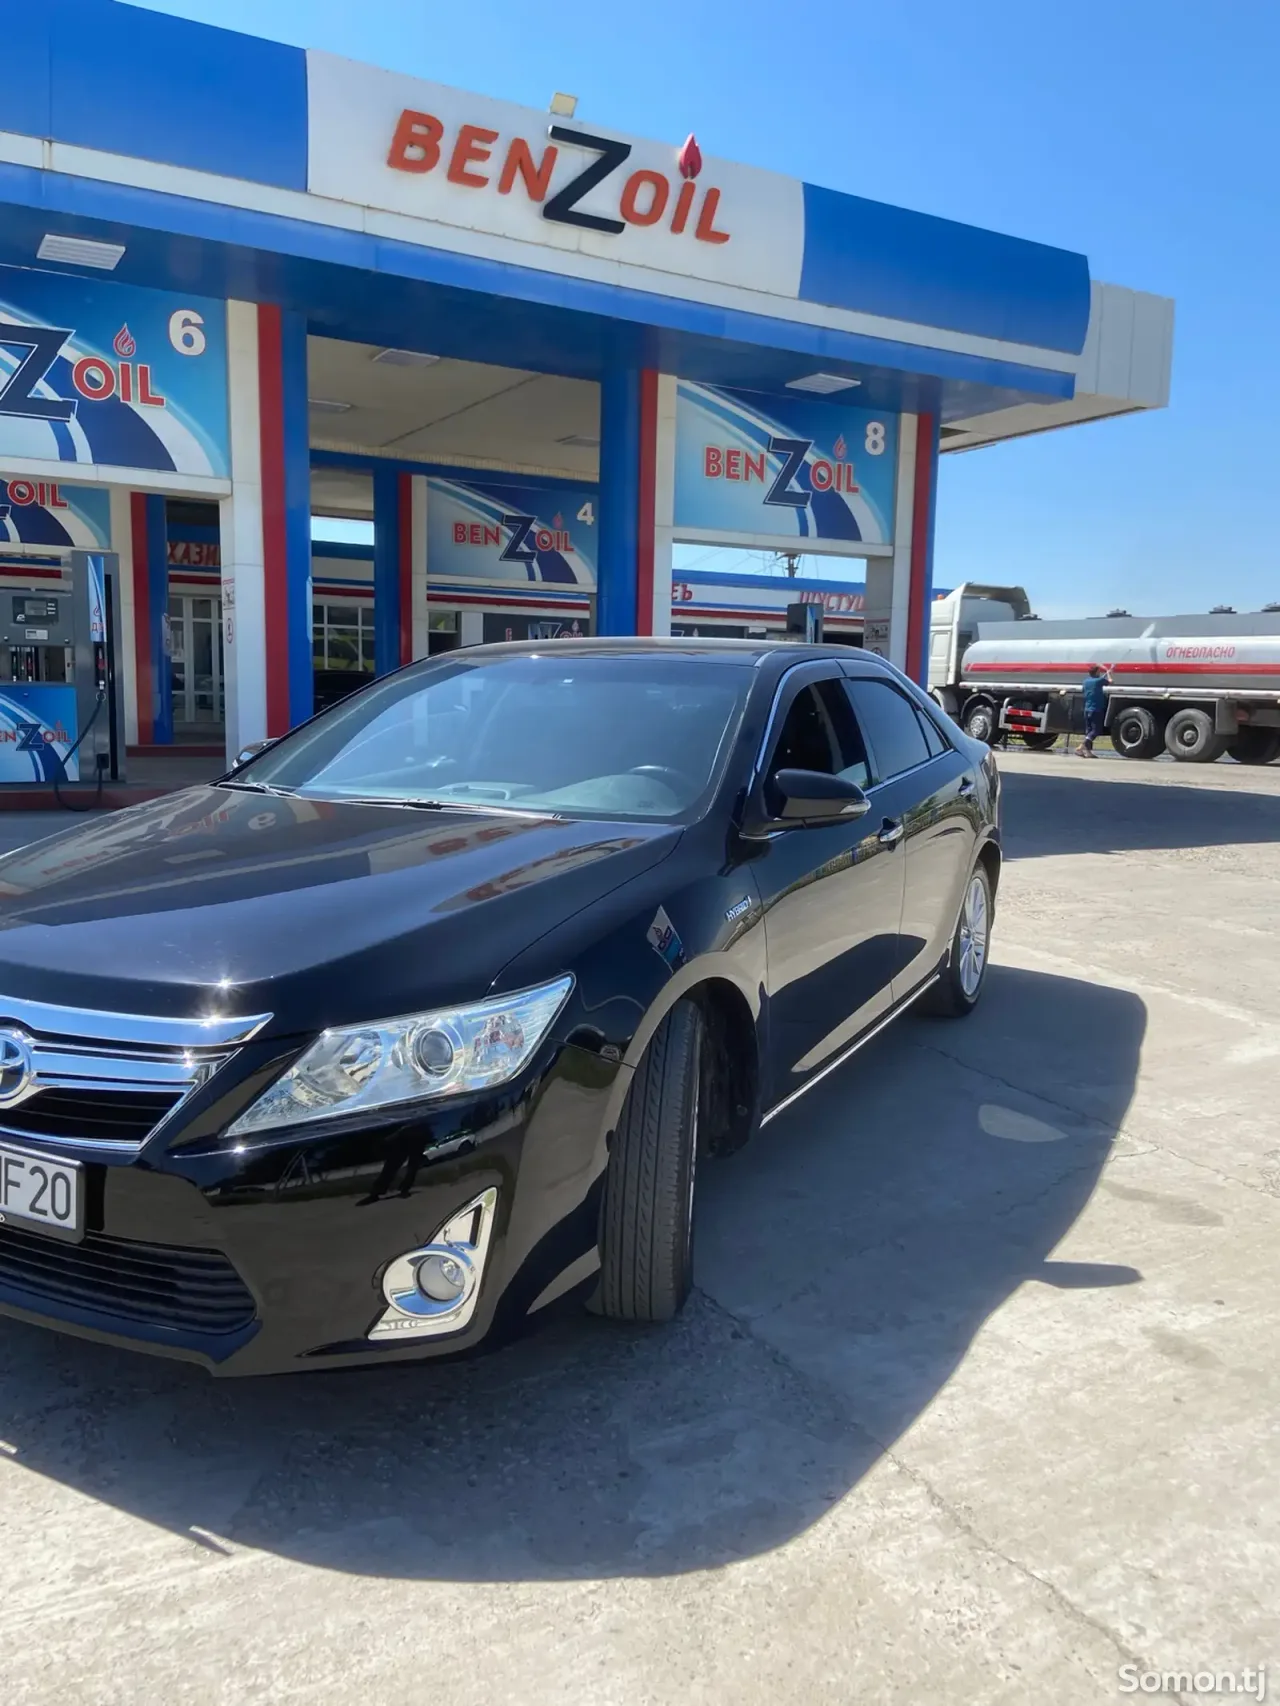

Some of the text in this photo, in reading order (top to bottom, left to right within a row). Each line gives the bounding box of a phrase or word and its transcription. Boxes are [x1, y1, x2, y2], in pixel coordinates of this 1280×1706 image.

[386, 108, 731, 245] BENZOIL
[168, 309, 206, 357] 6
[864, 421, 886, 456] 8
[703, 435, 860, 509] BENZOIL
[452, 512, 575, 564] BENZOIL
[576, 502, 595, 526] 4
[1165, 645, 1236, 659] ОГНЕОПАСНО
[0, 1155, 71, 1220] F20
